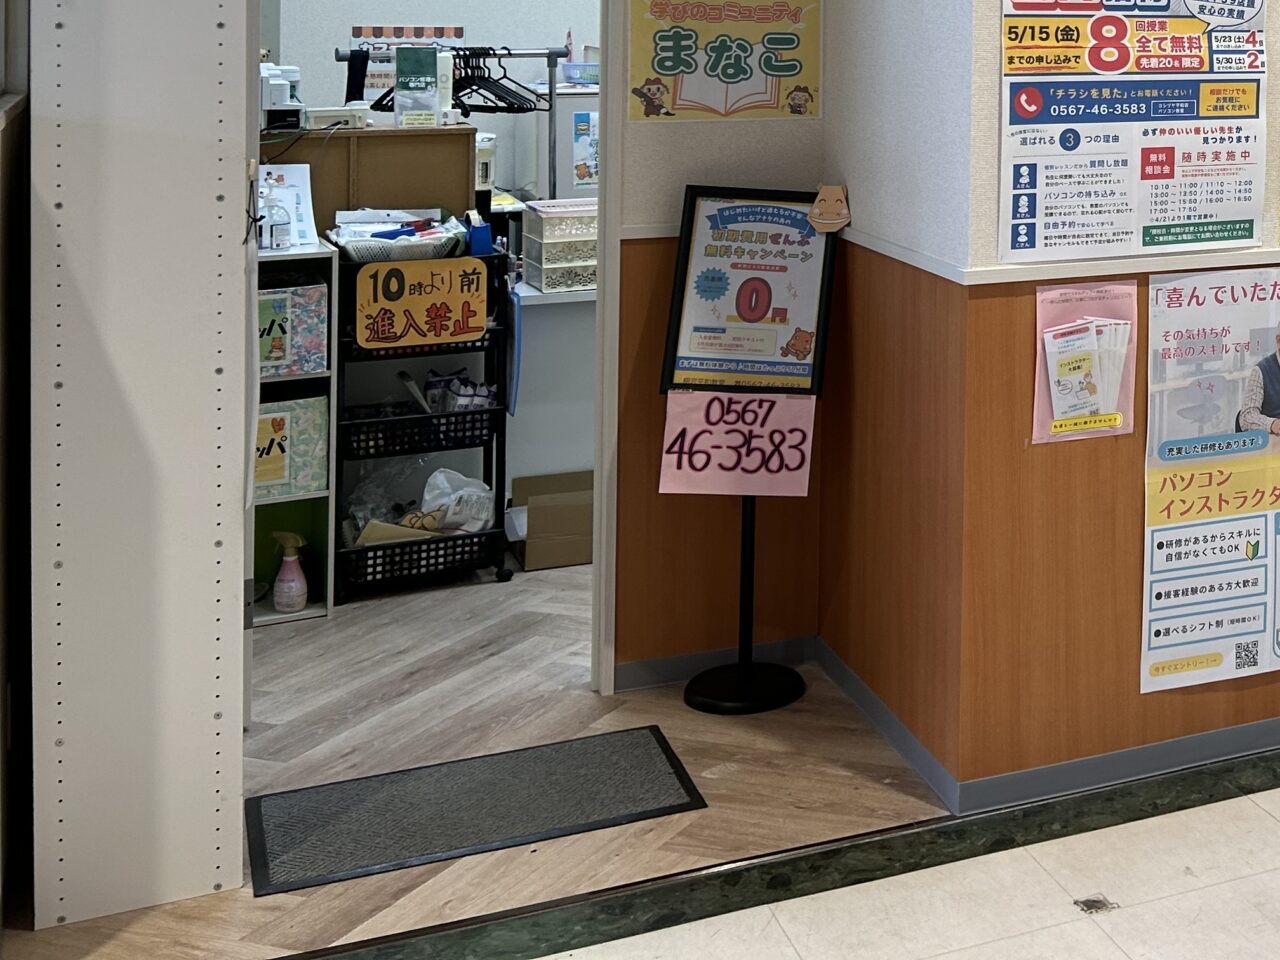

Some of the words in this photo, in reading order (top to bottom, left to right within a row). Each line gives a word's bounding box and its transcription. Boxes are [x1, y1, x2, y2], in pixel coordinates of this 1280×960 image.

[1197, 5, 1246, 21] 安心の実績
[1136, 21, 1168, 32] 回授業
[1088, 16, 1131, 72] 8
[1136, 35, 1202, 53] 全て無料
[652, 25, 802, 84] まなこ
[1007, 54, 1081, 66] までの申し込みで
[1050, 103, 1147, 116] 0567-46-3583
[1020, 136, 1056, 146] 選ばれる
[1084, 134, 1120, 144] つの理由
[1150, 153, 1166, 162] 無料
[1182, 150, 1251, 163] 随時実施中
[1145, 165, 1171, 175] 相談会
[1044, 190, 1116, 200] パソコンの持ち込み
[711, 229, 811, 247] 初期費用ぜんぶ
[704, 244, 813, 263] 無料キャンペーン
[368, 266, 483, 305] 10時より前
[364, 300, 486, 344] 進入禁止
[1160, 326, 1231, 343] その気持ちが
[1160, 341, 1262, 360] 最高のスキルです！
[704, 395, 777, 428] 0567
[665, 427, 807, 474] 46-3583
[1159, 470, 1233, 493] パソコン
[1165, 527, 1261, 549] 研修があるからスキルに
[1165, 544, 1240, 563] 自信がなくてもOK
[1163, 578, 1259, 600] 接客経験のある方大歓迎
[1162, 619, 1224, 638] 選べるシフト制
